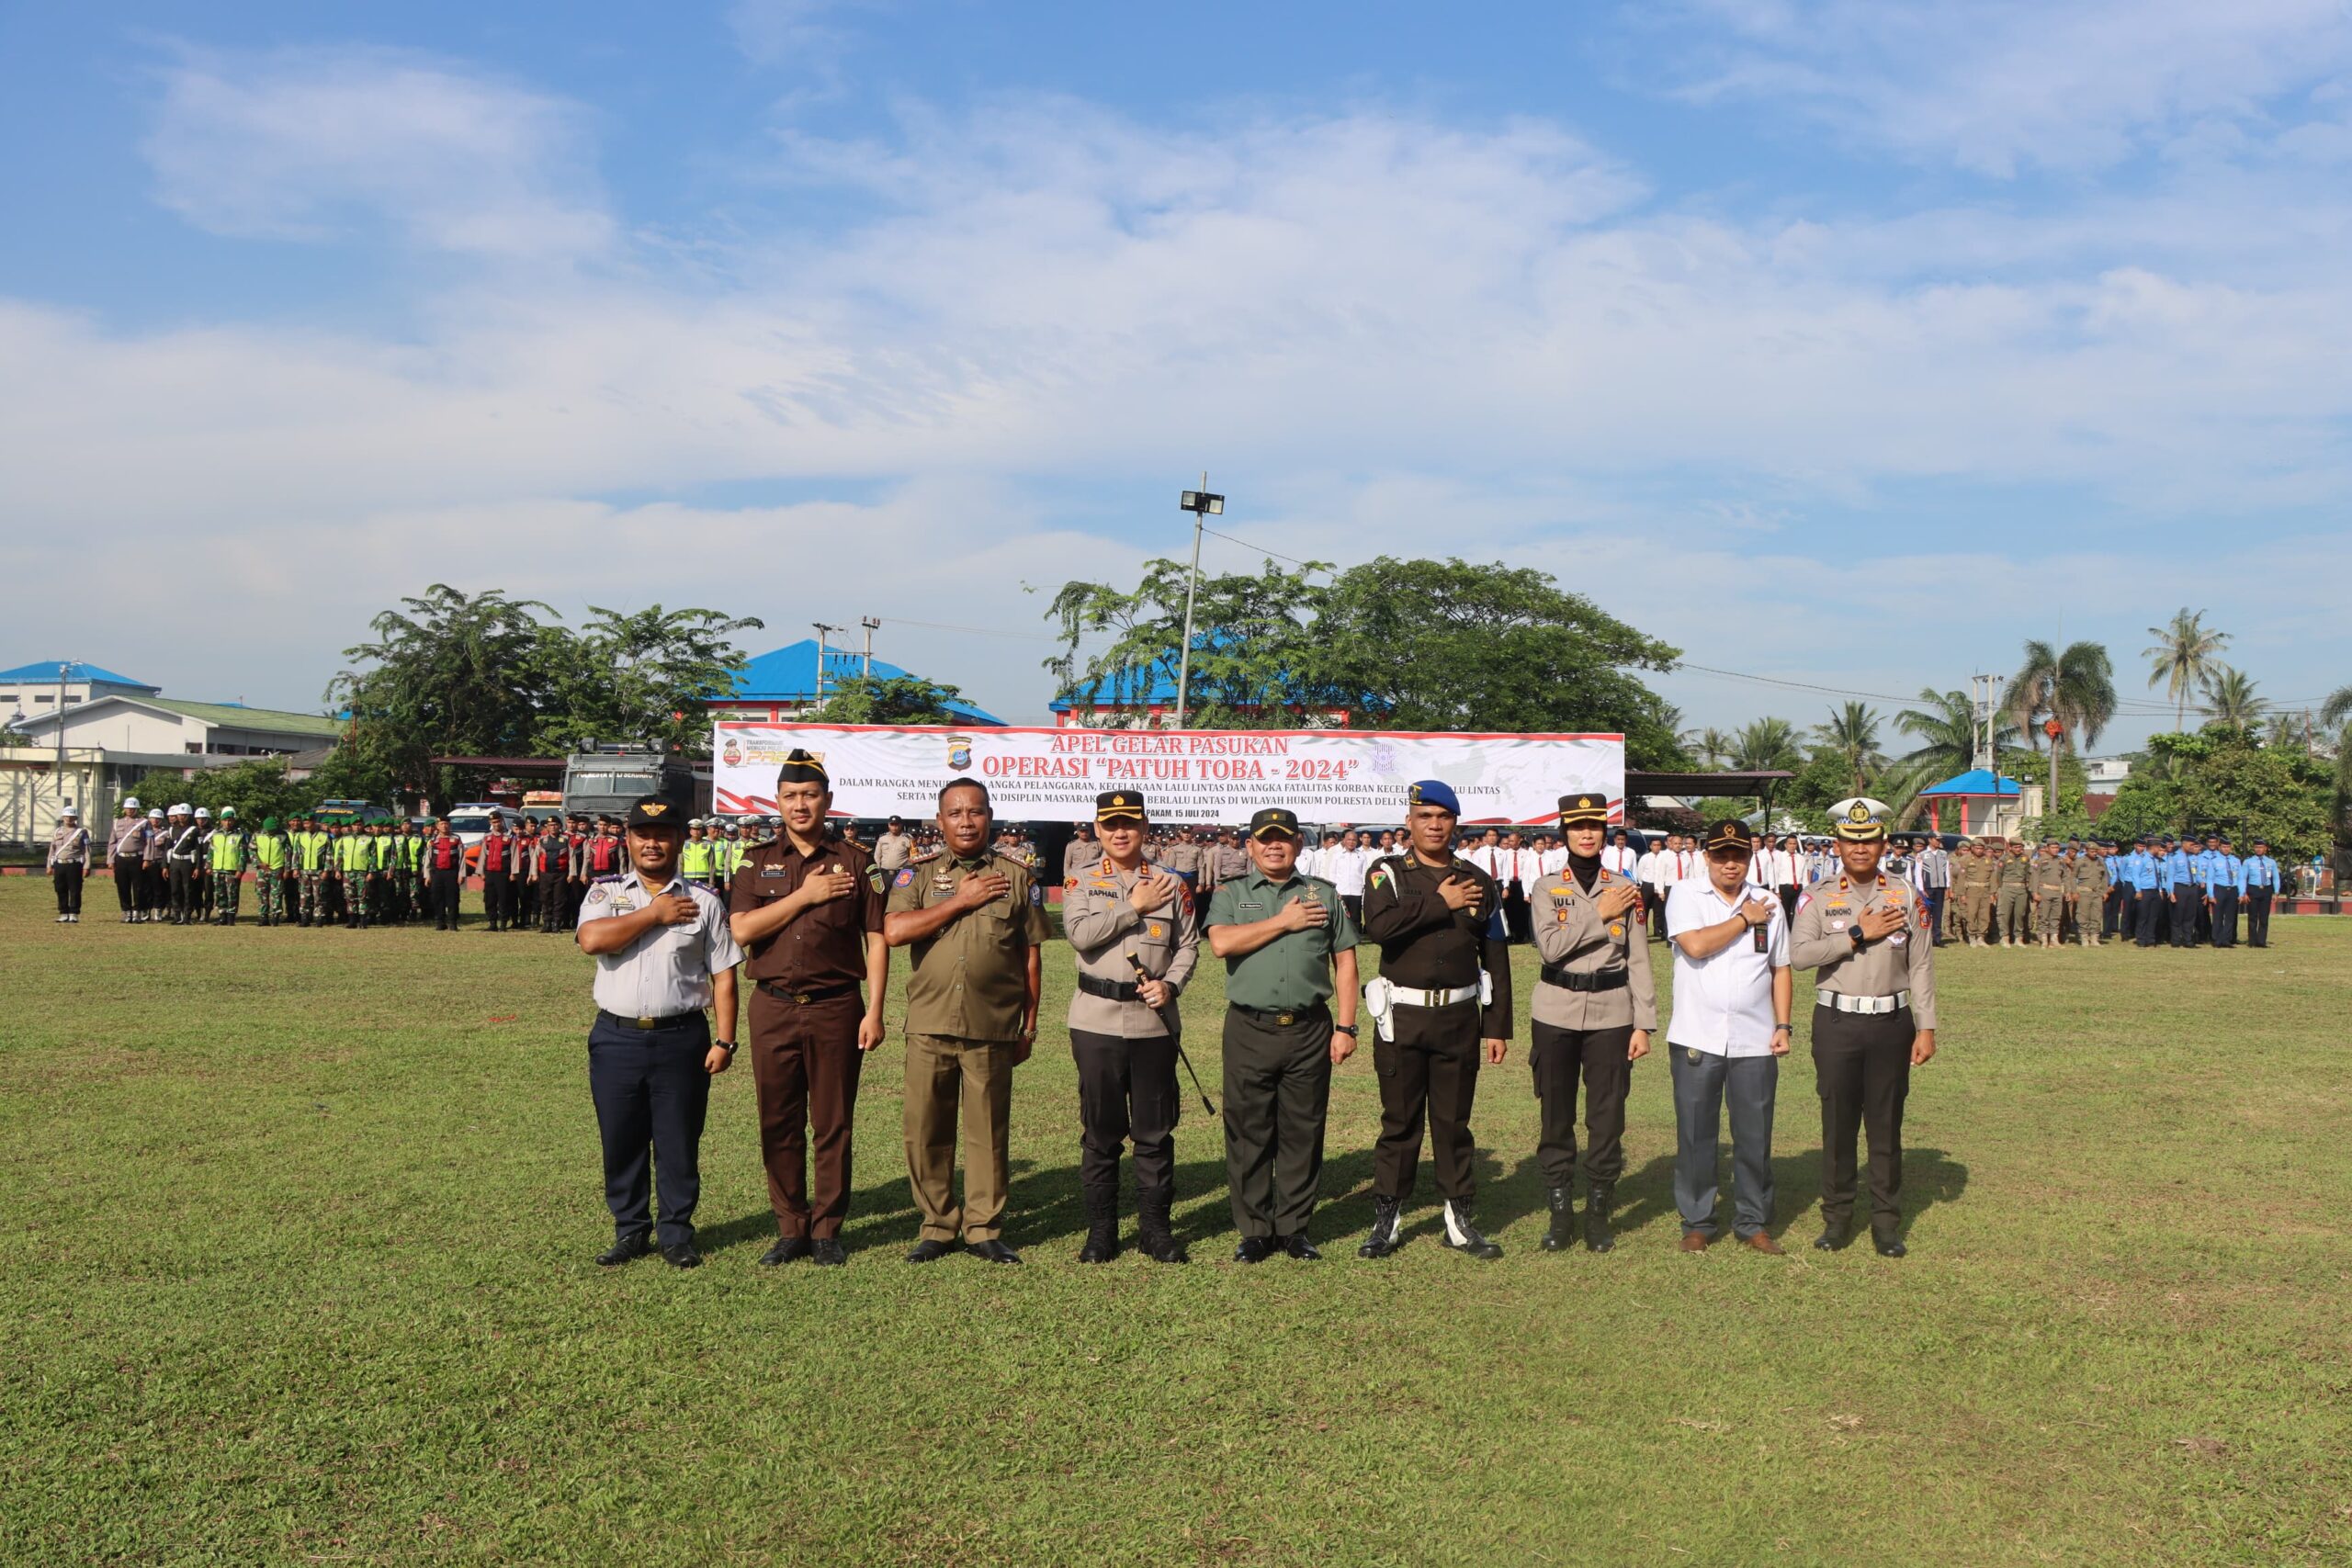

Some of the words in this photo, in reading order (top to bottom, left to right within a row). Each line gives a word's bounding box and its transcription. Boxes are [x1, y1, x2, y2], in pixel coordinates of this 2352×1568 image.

[1050, 735, 1107, 754] APEL
[1112, 736, 1183, 755] GELAR
[1190, 736, 1291, 756] PASUKAN
[982, 756, 1091, 779] OPERASI
[1196, 759, 1266, 781] TOBA
[839, 778, 873, 787] DALAM
[876, 779, 915, 788] RANGKA
[989, 781, 1022, 790] ANGKA
[1024, 781, 1097, 791] PELANGGARAN,
[1100, 782, 1162, 792] KECELAKAAN
[1165, 783, 1189, 792] LALU
[1192, 784, 1225, 792] LINTAS
[1227, 784, 1247, 792] DAN
[1249, 784, 1282, 793] ANGKA
[1284, 784, 1333, 793] FATALITAS
[1335, 784, 1374, 794] KORBAN
[1468, 786, 1500, 795] LINTAS
[897, 792, 926, 801] SERTA
[1001, 794, 1042, 802] DISIPLIN
[1148, 795, 1191, 805] BERLALU
[1193, 795, 1226, 805] LINTAS
[1227, 796, 1238, 805] DI
[1240, 796, 1284, 805] WILAYAH
[1286, 796, 1322, 805] HUKUM
[1325, 796, 1373, 806] POLRESTA
[1374, 797, 1396, 806] DELI
[1175, 809, 1183, 818] 15
[1185, 809, 1200, 818] JULI
[1201, 809, 1220, 818] 2024
[1088, 889, 1119, 899] RAPHAEL
